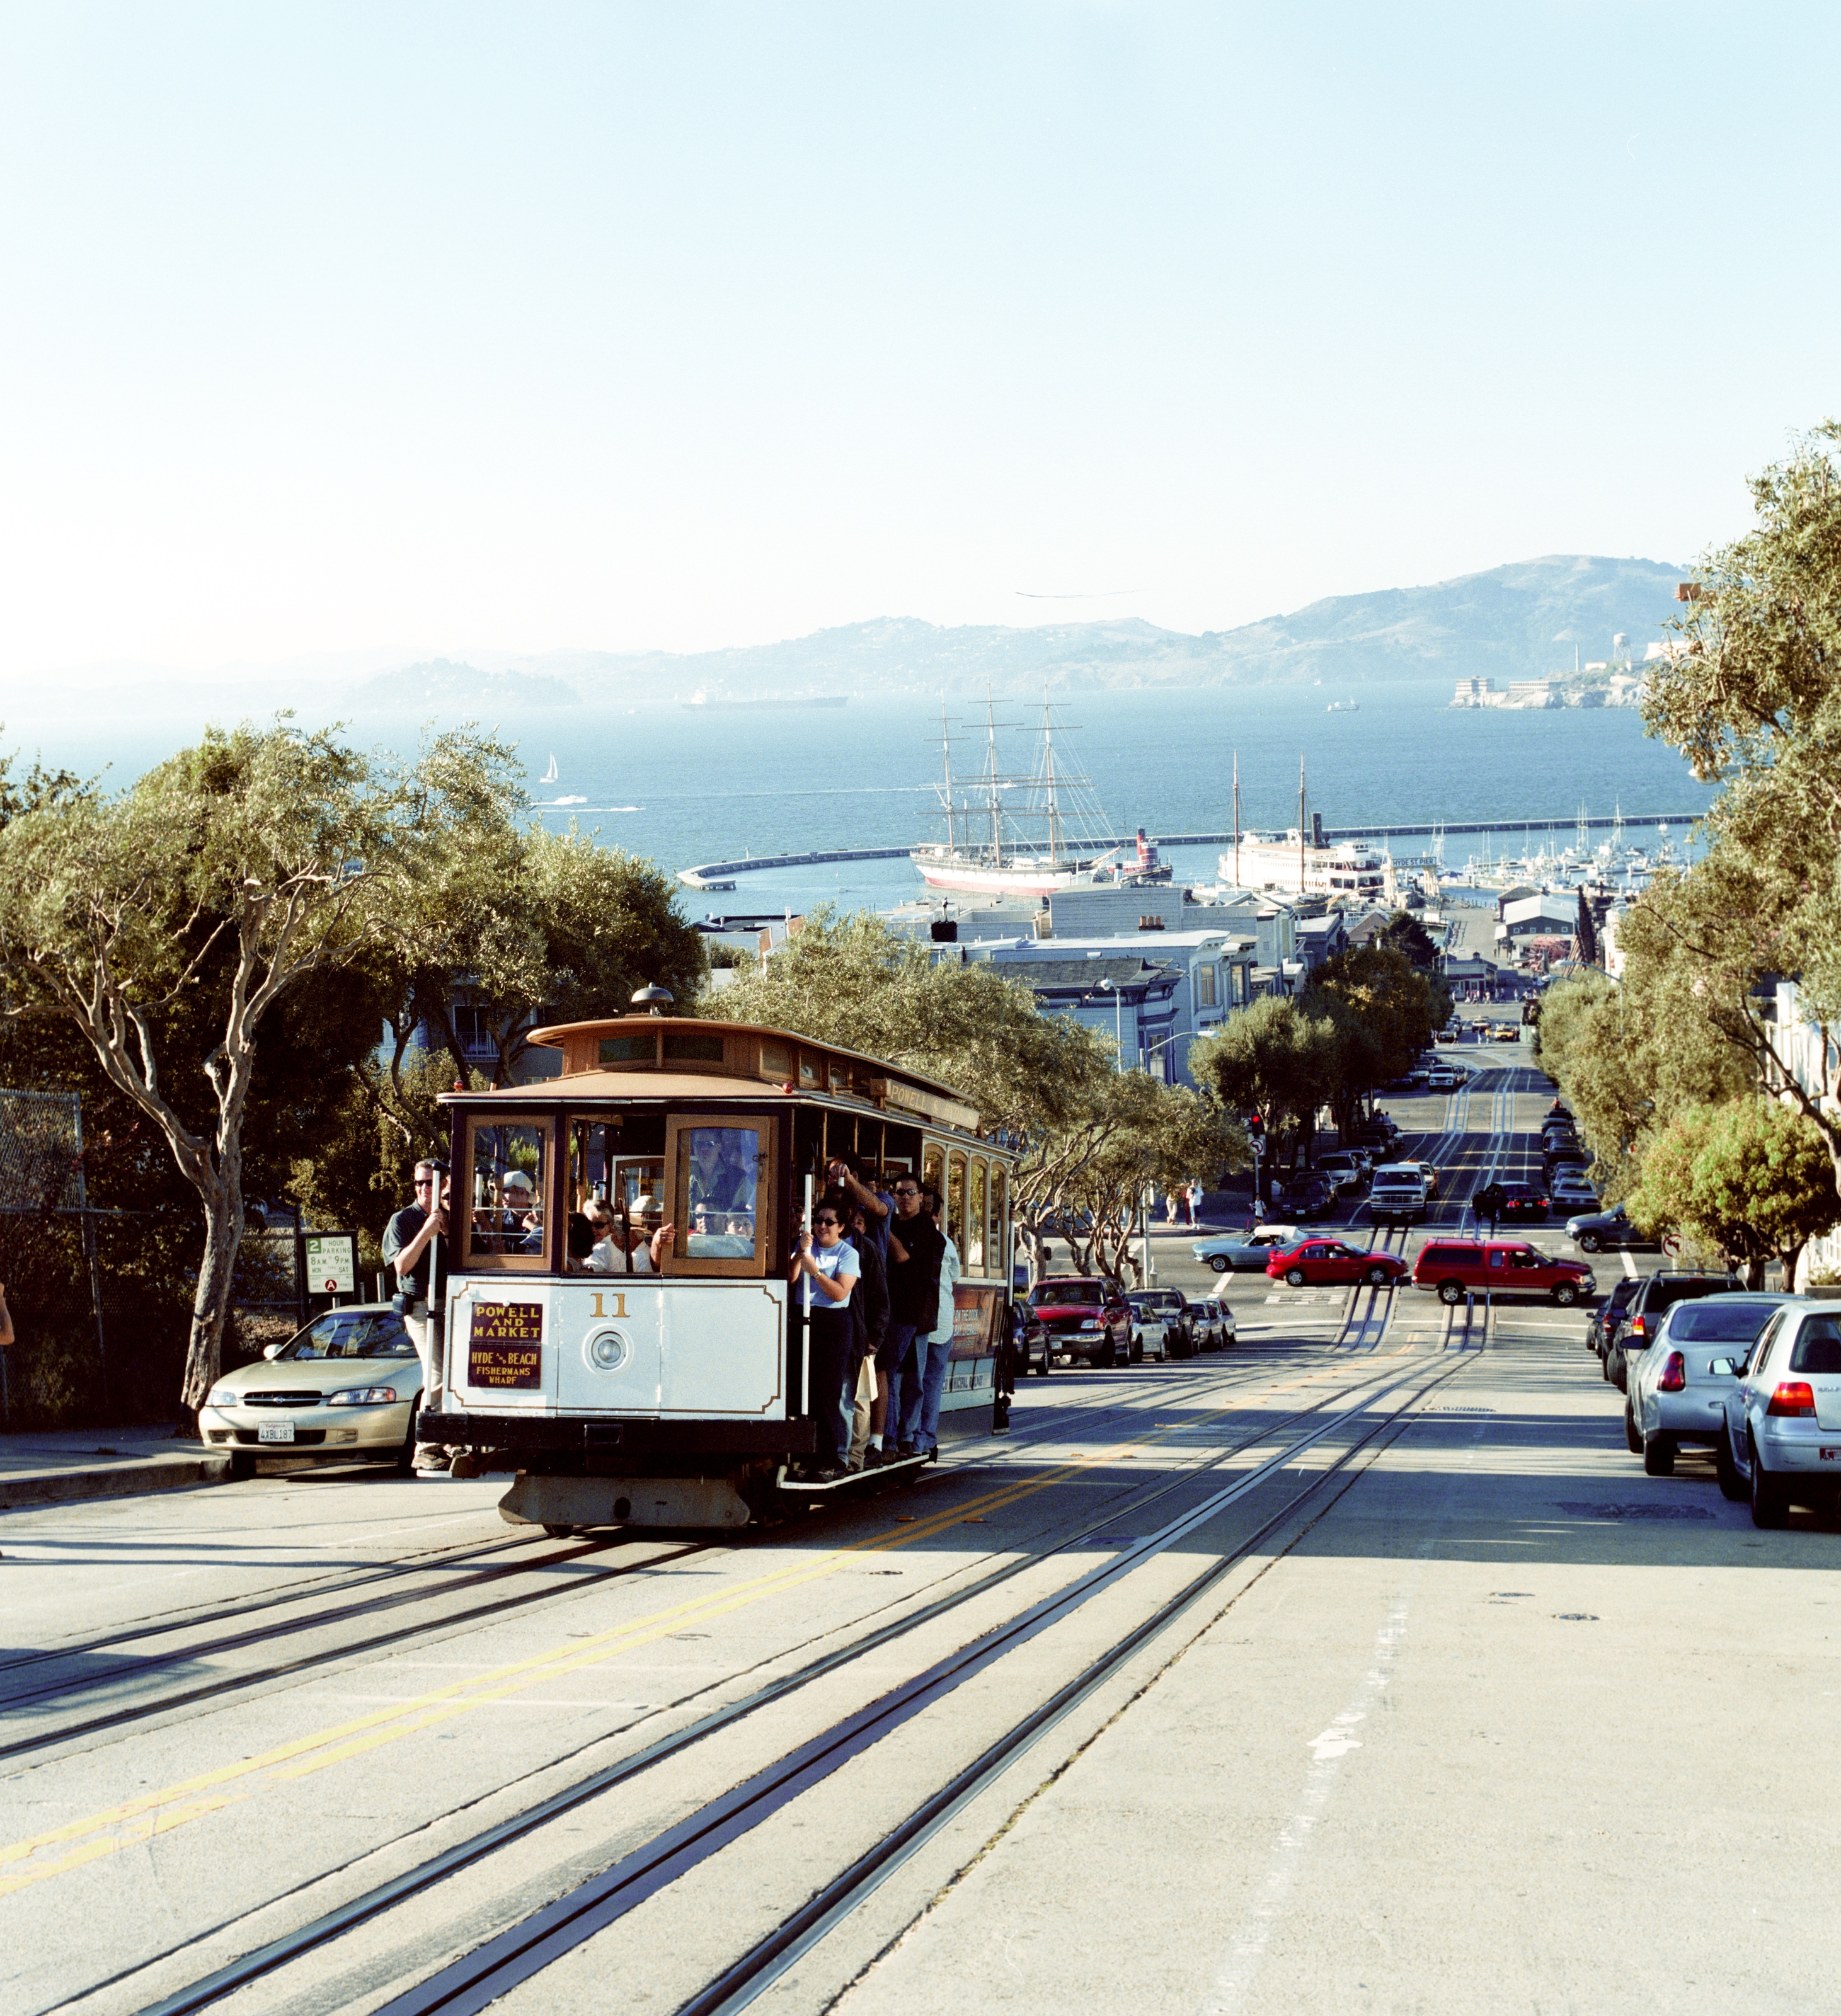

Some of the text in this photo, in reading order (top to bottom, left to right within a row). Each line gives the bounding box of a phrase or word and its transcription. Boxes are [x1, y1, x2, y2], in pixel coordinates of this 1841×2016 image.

[890, 1084, 927, 1111] POWELL
[309, 1240, 319, 1252] 2
[311, 1257, 316, 1265] 8
[334, 1256, 340, 1264] 9
[327, 1280, 335, 1289] A
[590, 1293, 631, 1317] 11
[476, 1307, 539, 1318] POWELL
[474, 1326, 540, 1337] MARKET
[472, 1352, 537, 1365] HYDE AND BEACH
[476, 1367, 530, 1375] FISHERMANS
[489, 1376, 517, 1384] WHARF
[260, 1429, 292, 1440] 4XBL187
